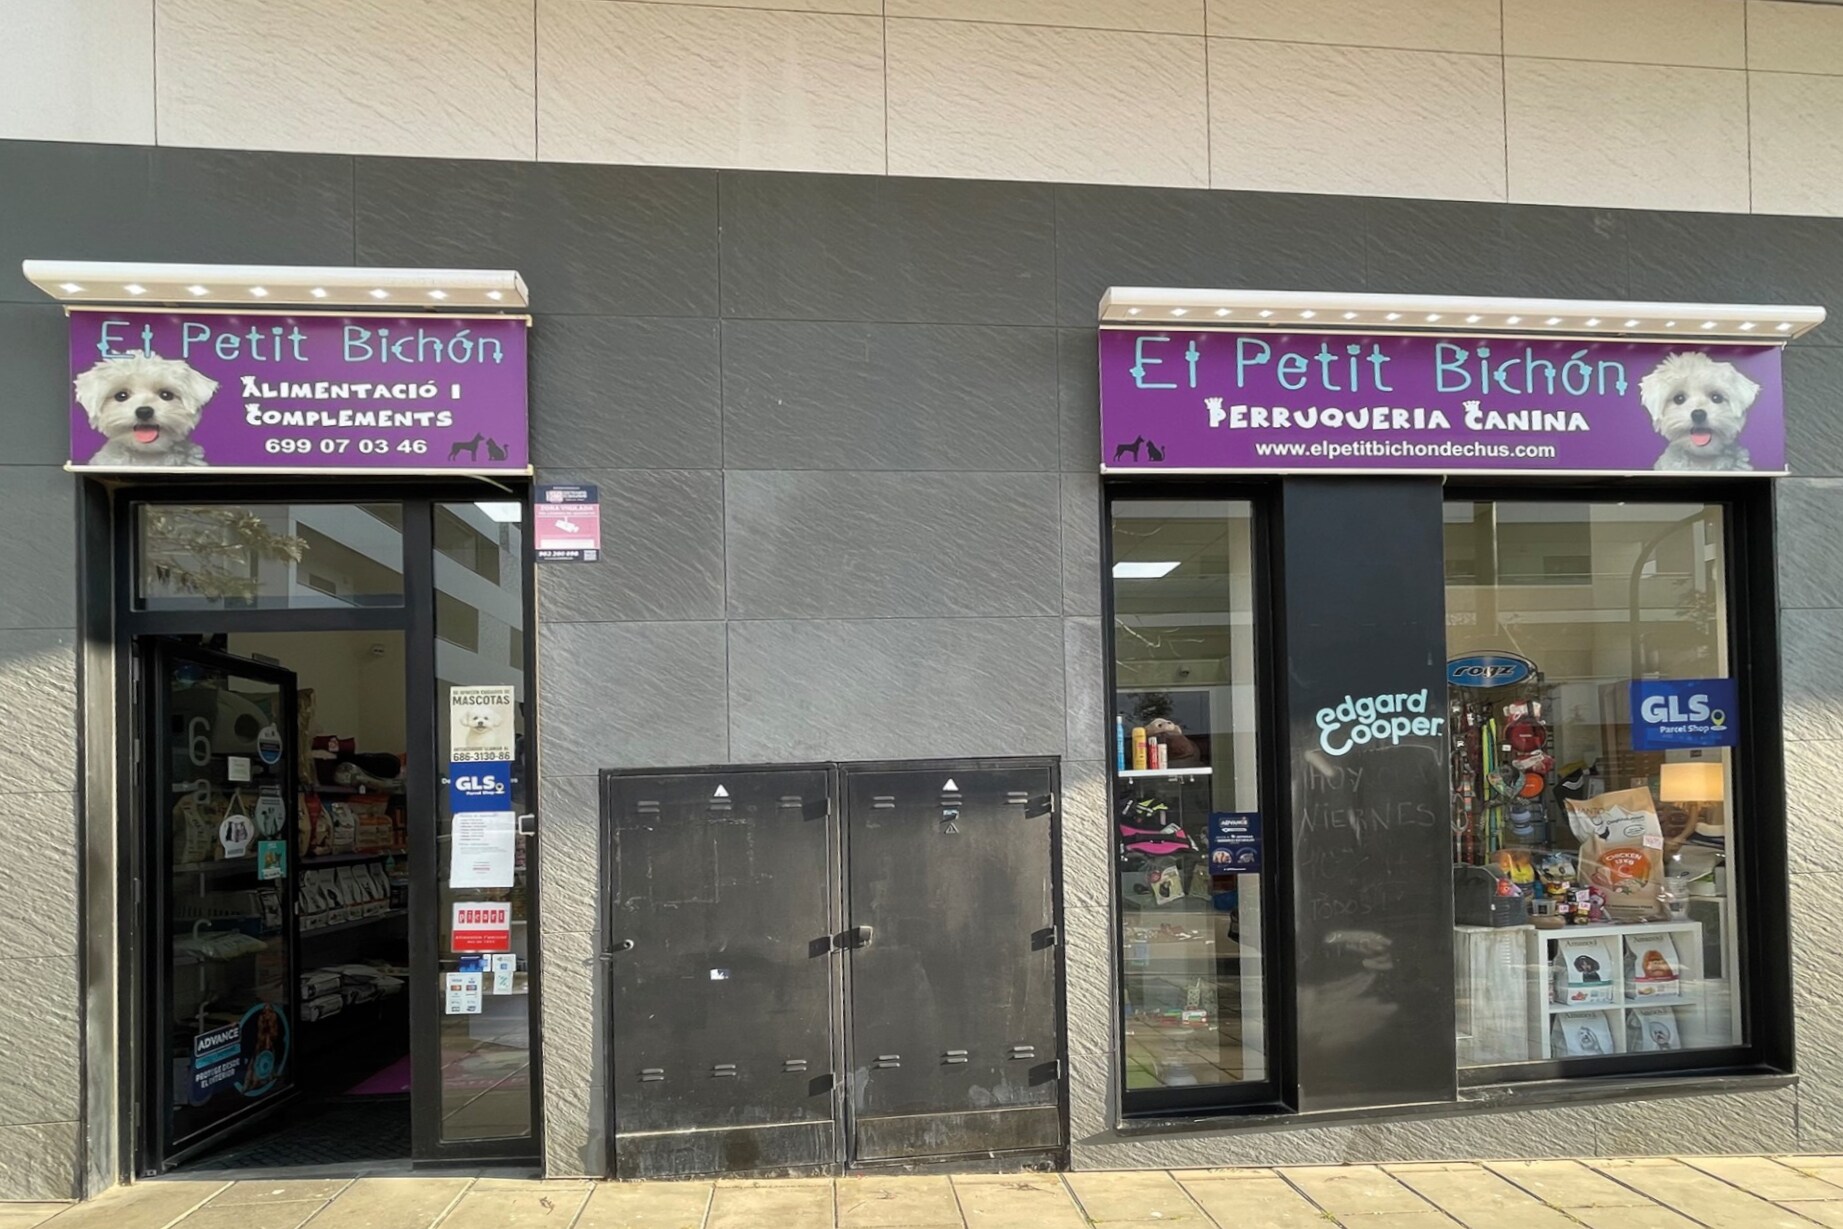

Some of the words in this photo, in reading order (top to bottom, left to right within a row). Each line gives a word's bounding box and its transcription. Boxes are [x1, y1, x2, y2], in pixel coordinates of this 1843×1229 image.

[97, 321, 153, 360] El
[182, 322, 308, 361] Petit
[344, 326, 503, 364] Bichón
[1130, 337, 1198, 389] El
[1237, 338, 1392, 392] Petit
[1435, 343, 1627, 396] Bichón
[240, 375, 438, 400] ALIMENTACIÓ
[244, 403, 453, 428] COMPLEMENTS
[1204, 397, 1451, 430] PERRUQUERIA
[1462, 400, 1590, 432] CANINA
[265, 438, 312, 453] 699
[320, 439, 350, 453] 07
[358, 439, 389, 454] 03
[396, 439, 428, 454] 46
[1255, 440, 1556, 459] www.elpetitbichondechus.com
[453, 695, 510, 706] MASCOTAS
[1316, 688, 1428, 728] edgard
[1641, 694, 1710, 724] GLS
[1320, 716, 1445, 755] Cooper
[1659, 725, 1687, 734] Parcel
[1688, 724, 1710, 733] Shop
[455, 775, 496, 791] GLS
[198, 1028, 239, 1051] ADVANCE
